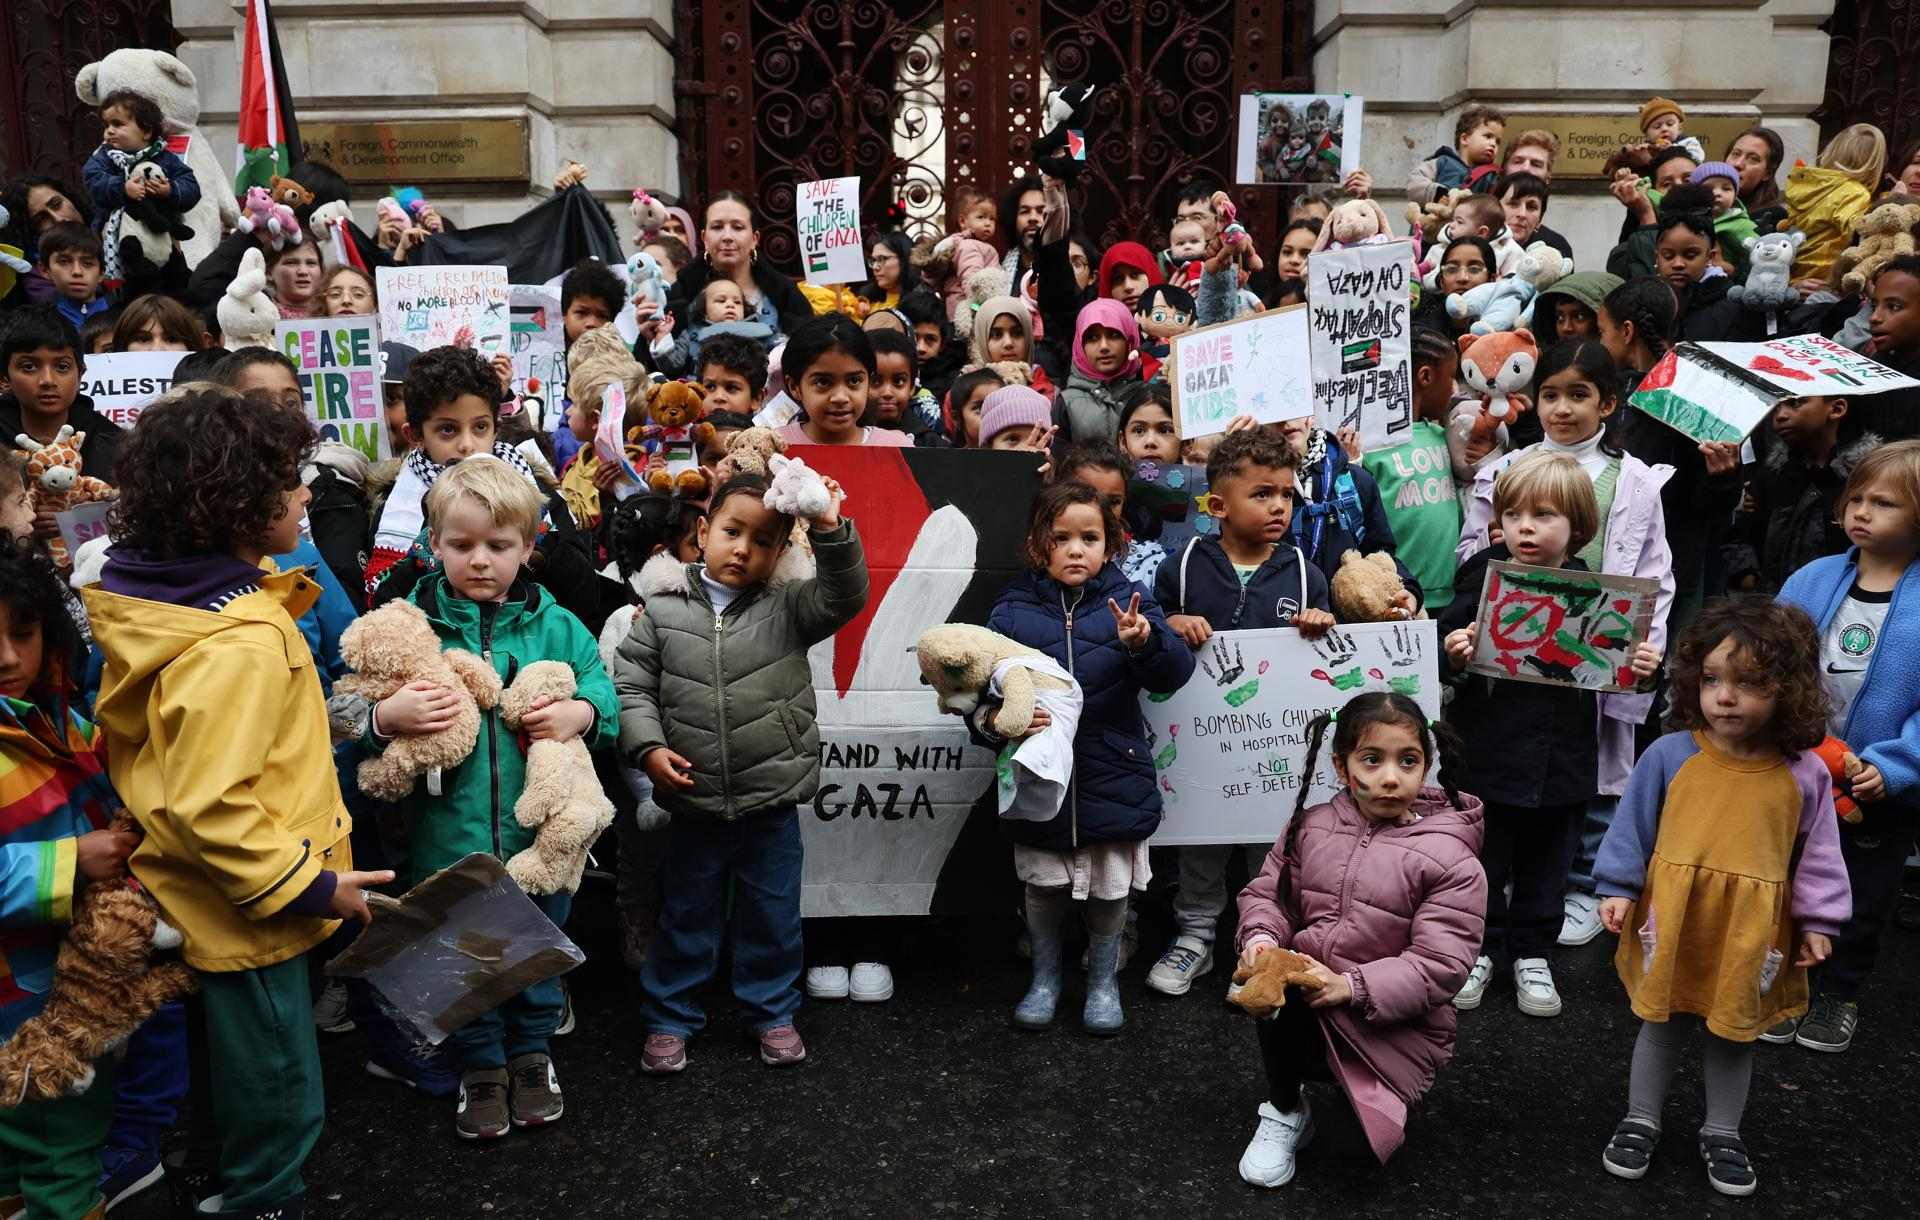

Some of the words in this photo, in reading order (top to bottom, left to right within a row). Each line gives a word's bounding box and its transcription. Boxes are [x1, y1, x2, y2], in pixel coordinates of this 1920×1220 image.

[389, 137, 479, 150] Commonwealth
[1567, 148, 1576, 159] &
[1568, 133, 1615, 149] Foreign,
[352, 152, 427, 166] Development
[430, 151, 465, 165] Office
[806, 179, 840, 200] SAVE
[813, 198, 844, 215] THE
[798, 209, 856, 235] CHILDREN
[806, 234, 823, 252] OF
[825, 227, 860, 248] GAZA
[1326, 268, 1376, 299] GAZA
[1376, 262, 1403, 294] ON
[397, 300, 412, 311] NO
[416, 296, 448, 309] MORE
[284, 328, 372, 369] CEASE
[1184, 334, 1233, 370] SAVE
[1807, 336, 1855, 358] SAVE
[1855, 358, 1904, 380] THE
[79, 378, 172, 397] PALEST
[299, 371, 377, 420] FIRE
[1186, 387, 1239, 426] KIDS
[1193, 711, 1273, 738] BOMBING
[818, 741, 880, 769] TAND
[894, 744, 963, 772] WITH
[1220, 741, 1232, 754] IN
[1257, 758, 1290, 774] NOT
[813, 783, 935, 822] GAZA
